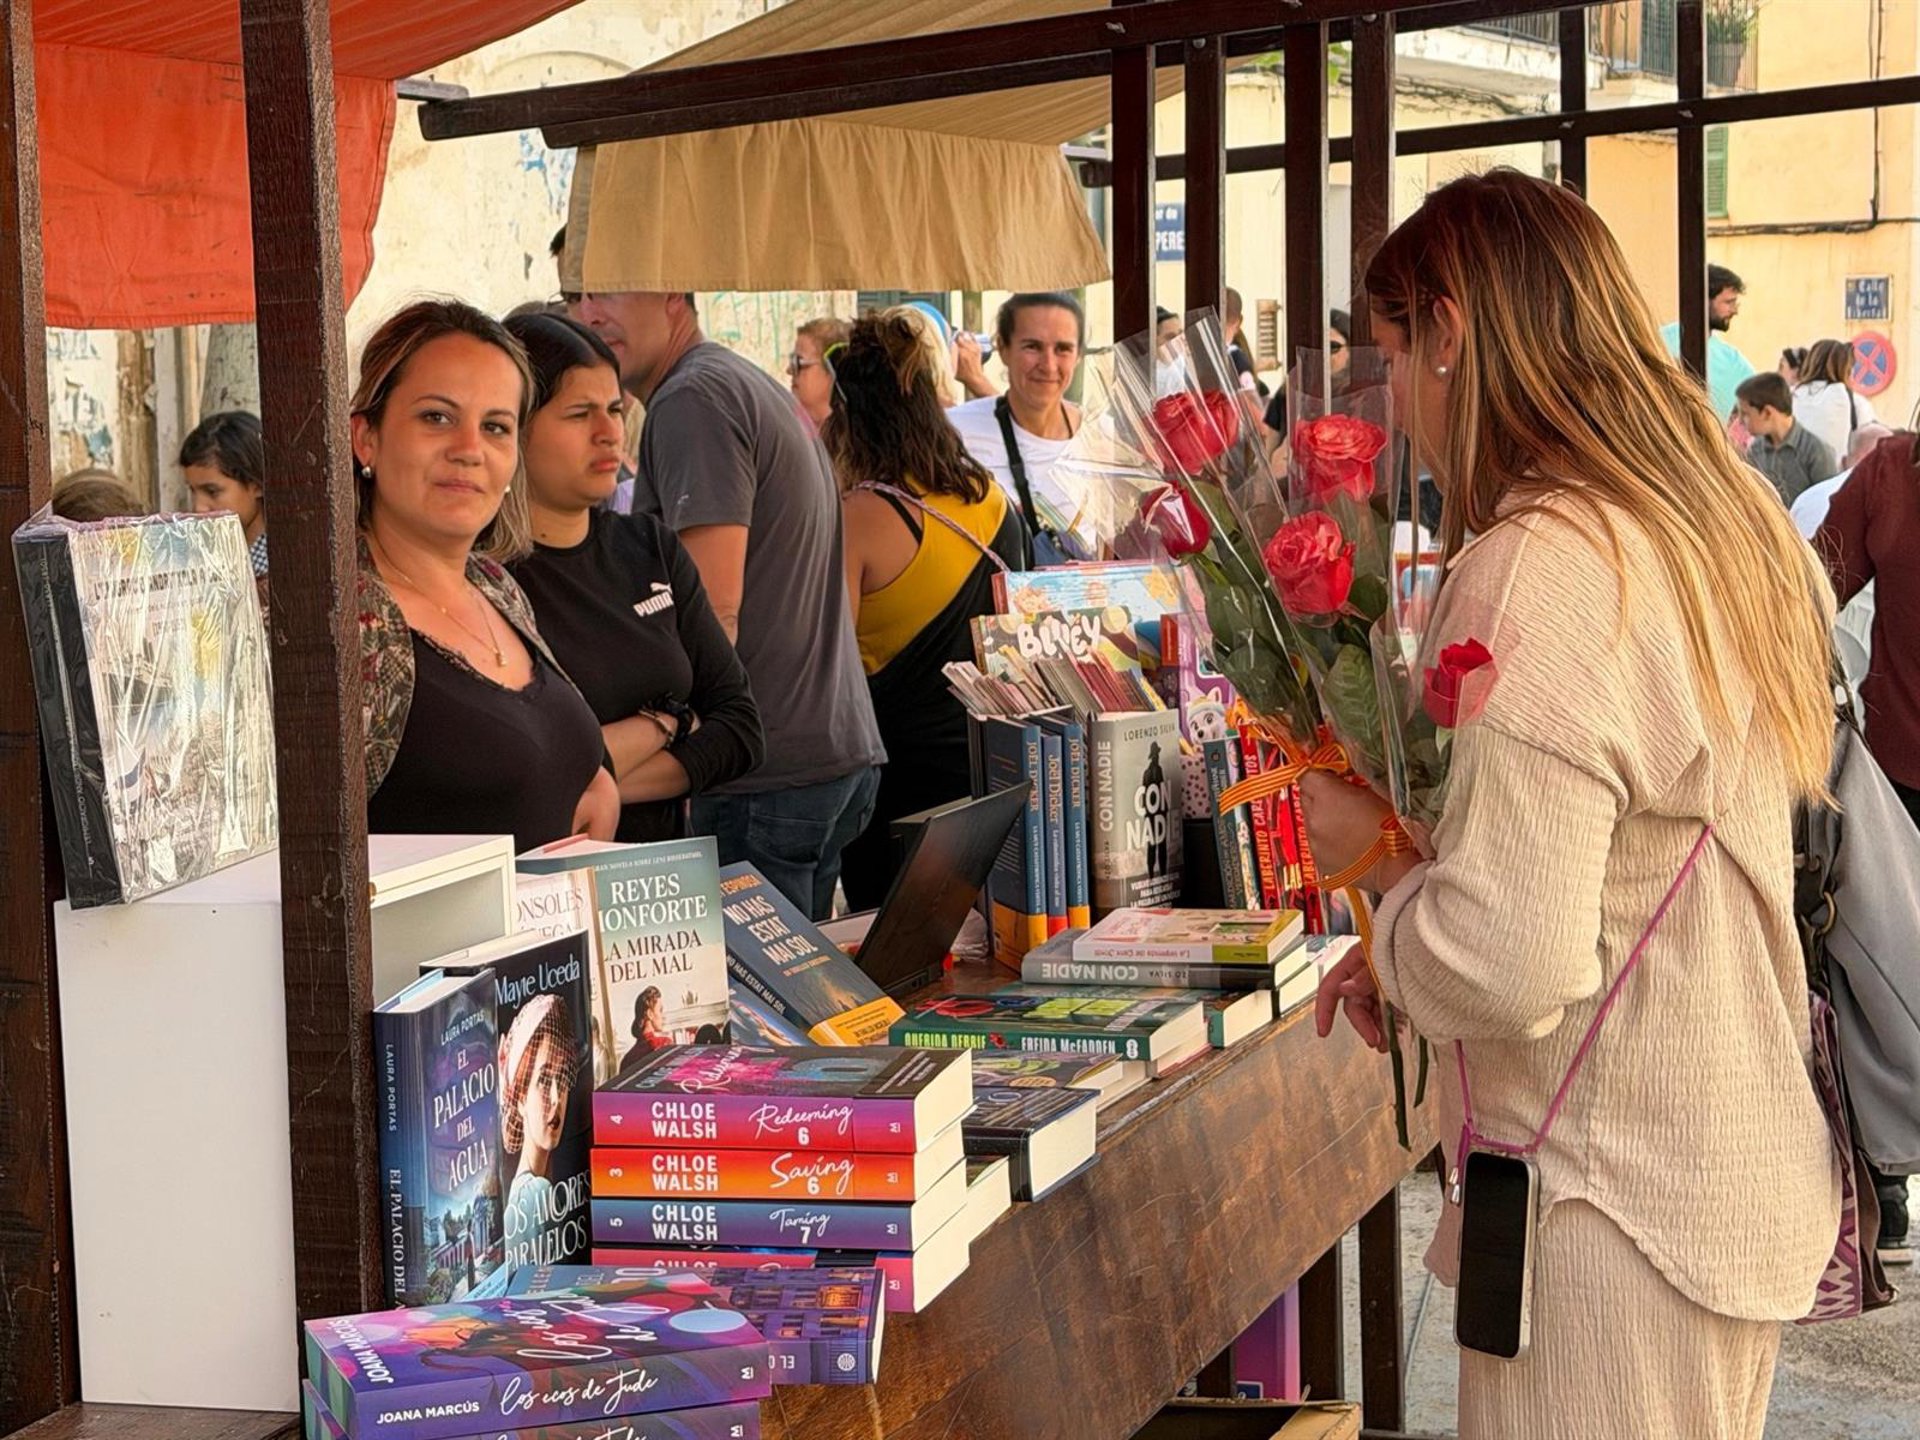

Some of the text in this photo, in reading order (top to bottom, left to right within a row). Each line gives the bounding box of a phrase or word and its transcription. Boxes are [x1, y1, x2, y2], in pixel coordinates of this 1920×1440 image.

[633, 591, 674, 617] PUMA
[1124, 724, 1175, 742] LORENZO SILVA
[1098, 740, 1111, 792] NADIE
[1070, 768, 1081, 808] DICKER
[1134, 779, 1172, 817] CON
[1049, 782, 1063, 823] Dicker
[1101, 793, 1114, 832] CON
[1126, 810, 1181, 851] NADIE
[1256, 830, 1276, 890] LABERINTO
[611, 873, 681, 905] REYES
[722, 874, 763, 895] ESPINOSA
[723, 895, 776, 926] NO HAS
[627, 928, 703, 958] MIRADA
[748, 916, 791, 943] ESTAT
[762, 941, 796, 966] MAI
[785, 934, 819, 956] SOL
[495, 953, 580, 1010] Mayte Uceda
[610, 953, 694, 984] DEL MAL
[1041, 962, 1096, 981] NADIE
[1099, 963, 1138, 981] CON
[1149, 970, 1173, 979] SILVA
[726, 955, 787, 1016] NO HAS ESTAT MAI SOL
[441, 1010, 485, 1046] LAURA PORTAS
[904, 1032, 948, 1048] QUERIDA
[457, 1049, 469, 1070] EL
[1021, 1037, 1116, 1054] FREIDA McFADDEN
[386, 1044, 397, 1132] LAURA PORTAS
[434, 1063, 494, 1128] PALACIO
[610, 1114, 623, 1124] 4
[652, 1102, 715, 1119] CHLOE
[748, 1103, 853, 1140] Redeeming
[457, 1116, 475, 1142] DEL
[652, 1121, 718, 1139] WALSH
[798, 1127, 810, 1145] 6
[448, 1138, 488, 1192] AGUA
[609, 1167, 623, 1177] 3
[652, 1155, 717, 1173] CHLOE
[770, 1152, 855, 1195] Saving
[389, 1169, 402, 1190] EL
[652, 1174, 719, 1191] WALSH
[807, 1176, 820, 1195] 6
[504, 1169, 591, 1239] OS AMORES
[652, 1204, 717, 1222] CHLOE
[390, 1193, 405, 1263] PALACIO
[610, 1217, 623, 1227] 5
[652, 1223, 718, 1241] WALSH
[769, 1208, 830, 1237] Taming
[801, 1226, 811, 1244] 7
[505, 1215, 587, 1279] PARALELOS
[394, 1266, 406, 1294] DEL
[354, 1349, 394, 1384] JOANA
[780, 1355, 795, 1369] EL
[542, 1387, 581, 1406] ecos
[582, 1378, 605, 1400] de
[604, 1368, 658, 1414] Jude
[376, 1401, 480, 1425] JOANA MARCÚS
